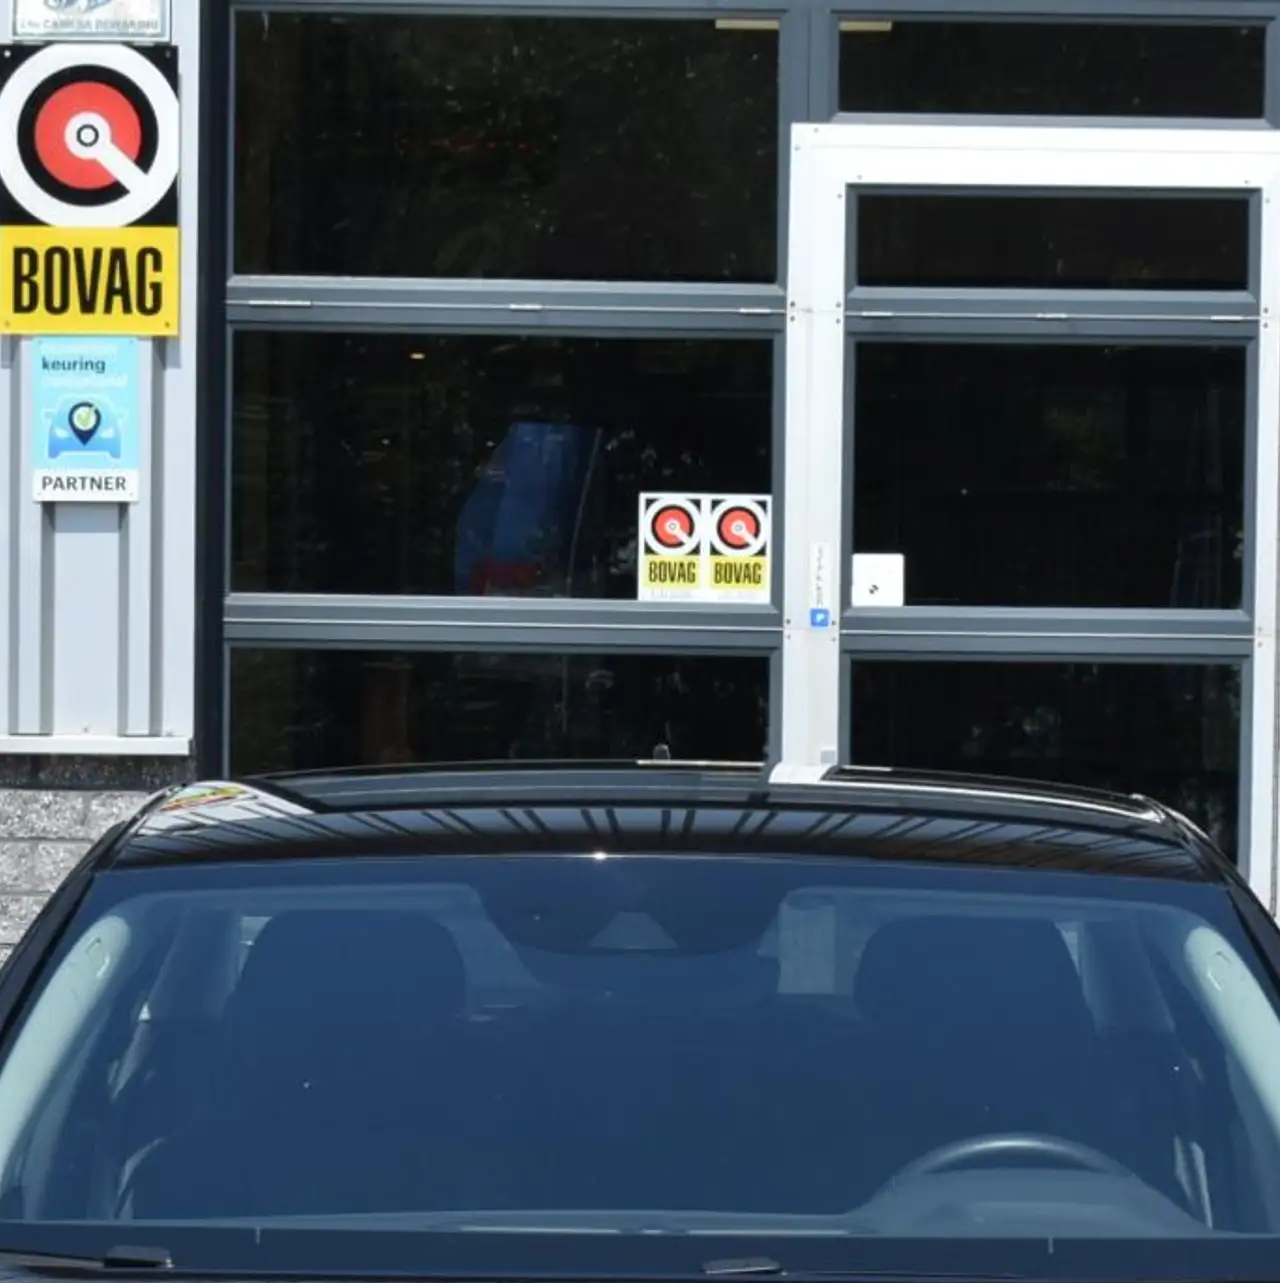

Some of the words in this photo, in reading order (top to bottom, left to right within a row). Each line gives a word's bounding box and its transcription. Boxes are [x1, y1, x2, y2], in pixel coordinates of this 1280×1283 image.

[12, 245, 163, 317] BOVAG
[41, 355, 106, 374] keuring
[41, 475, 127, 491] PARTNER
[648, 560, 696, 583] BOVAG
[713, 562, 762, 585] BOVAG
